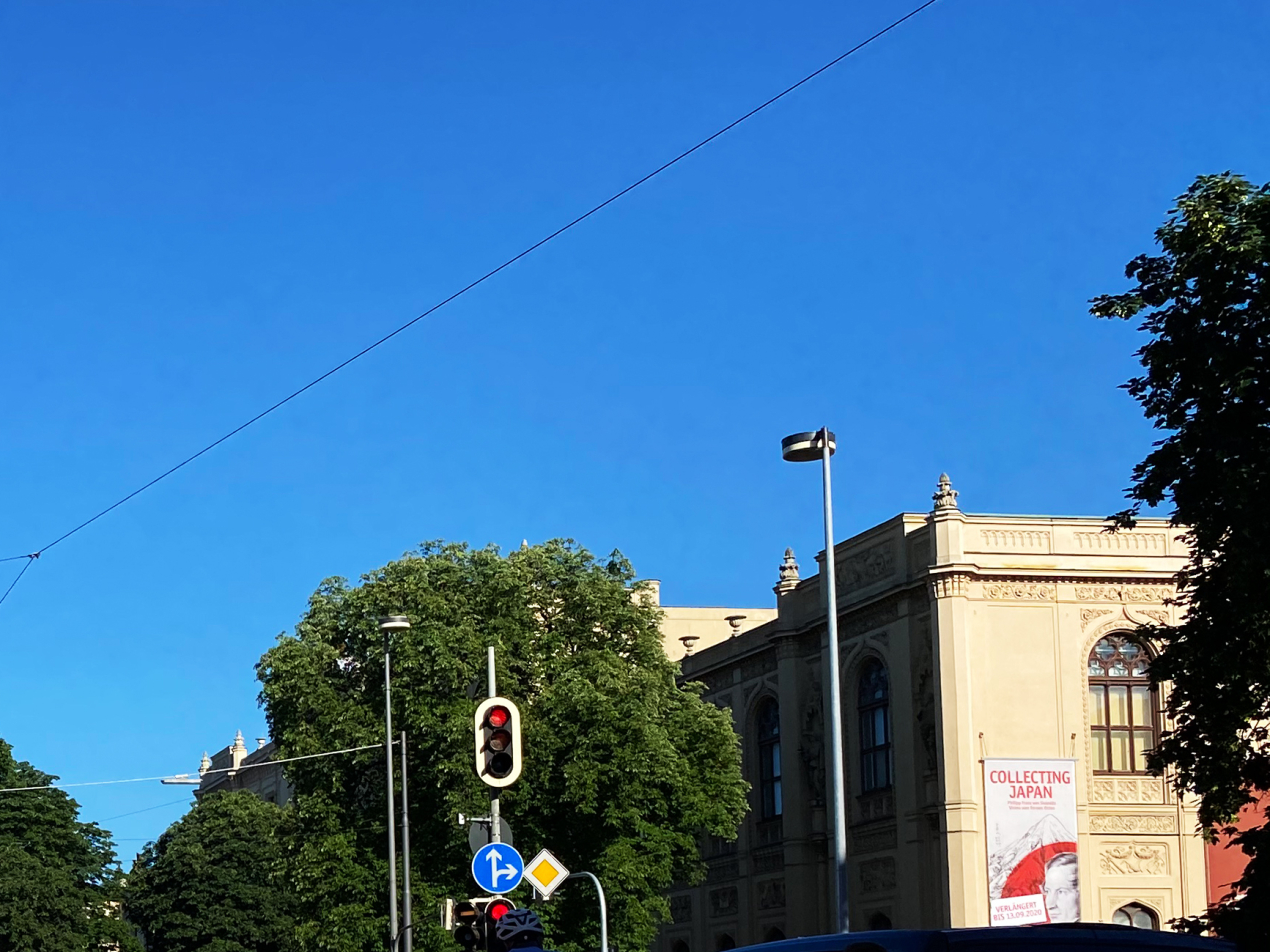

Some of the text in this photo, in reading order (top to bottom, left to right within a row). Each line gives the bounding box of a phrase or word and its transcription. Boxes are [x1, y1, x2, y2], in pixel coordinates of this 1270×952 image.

[990, 770, 1071, 784] COLLECTING
[1009, 785, 1053, 799] JAPAN
[995, 902, 1037, 913] VERLÄNGERT
[1006, 909, 1043, 919] 13.09.2020
